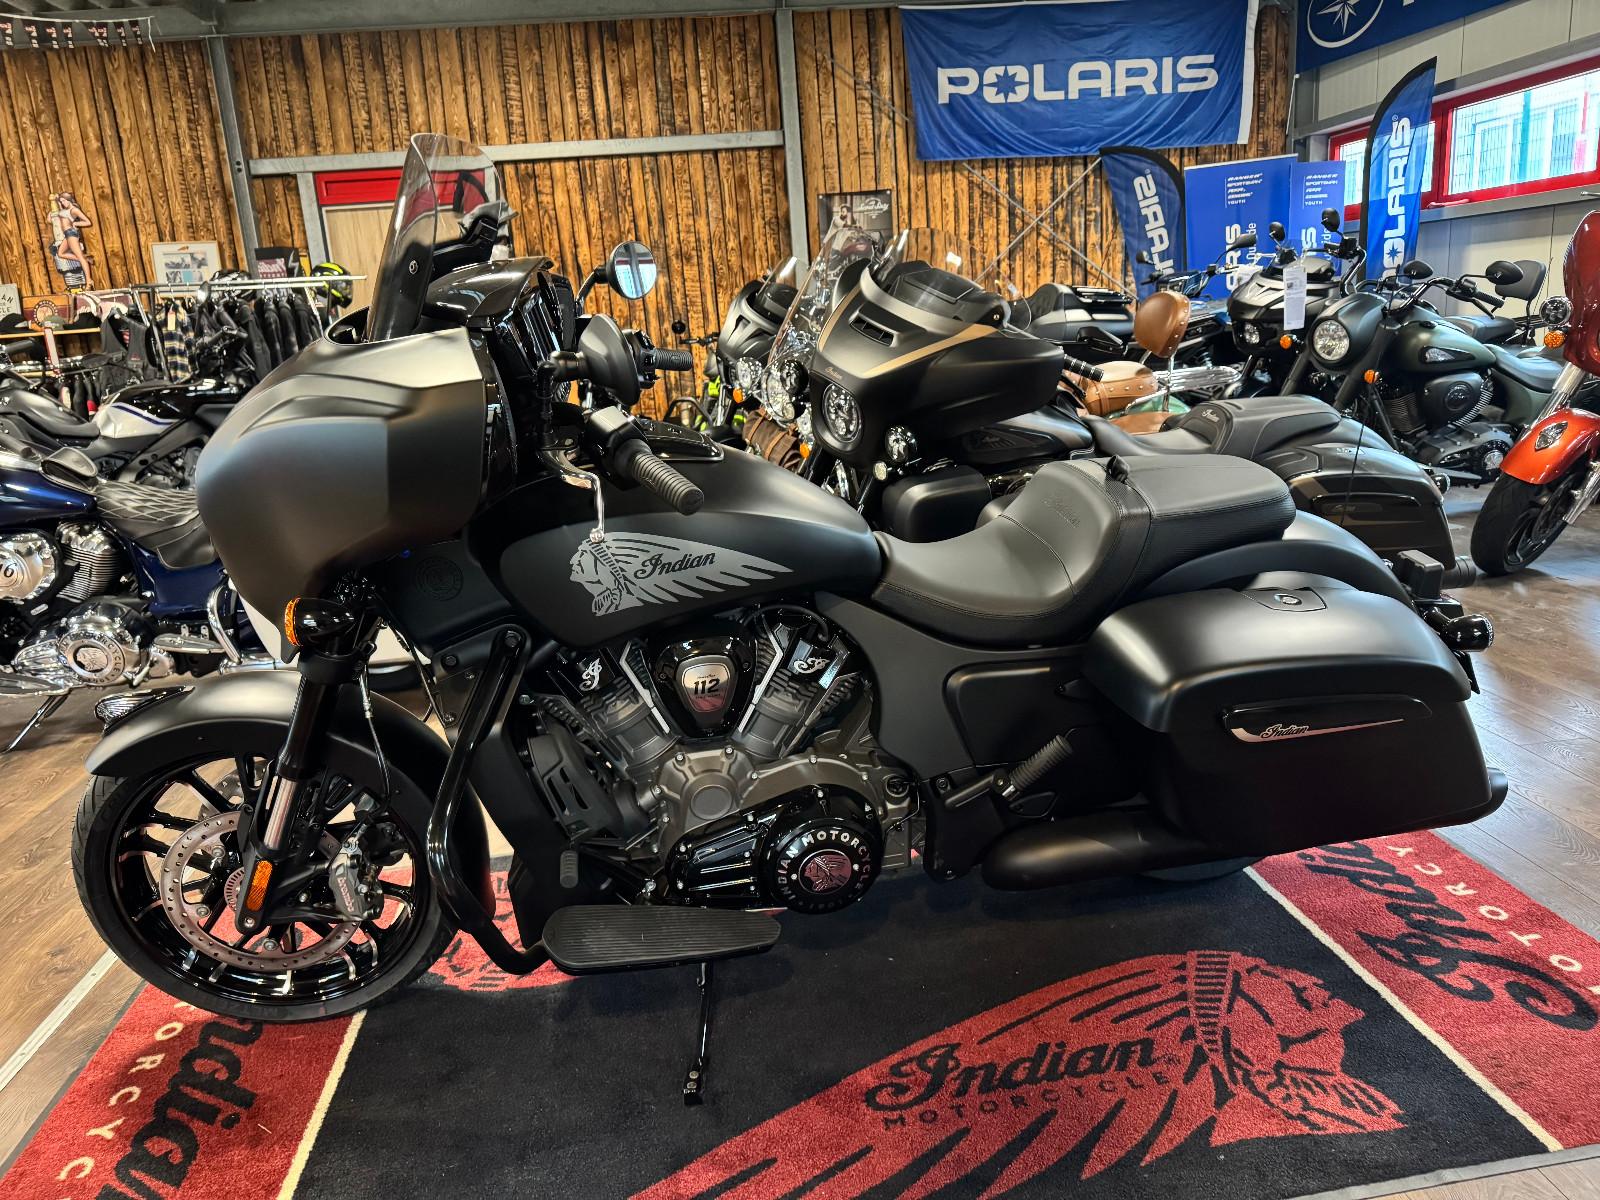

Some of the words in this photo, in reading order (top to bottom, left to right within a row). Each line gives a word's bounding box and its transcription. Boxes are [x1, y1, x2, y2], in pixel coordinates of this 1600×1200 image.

[937, 54, 1219, 105] POLARIS
[633, 552, 716, 580] Indian
[693, 678, 721, 695] 112
[1260, 723, 1310, 739] Indian
[777, 846, 800, 901] INDIAN
[801, 829, 872, 890] MOTORCYCLE
[337, 876, 355, 913] brembo
[1387, 845, 1600, 996] OTORCY
[864, 1036, 1156, 1112] Indian
[883, 1071, 1171, 1130] MOTORCYCLE
